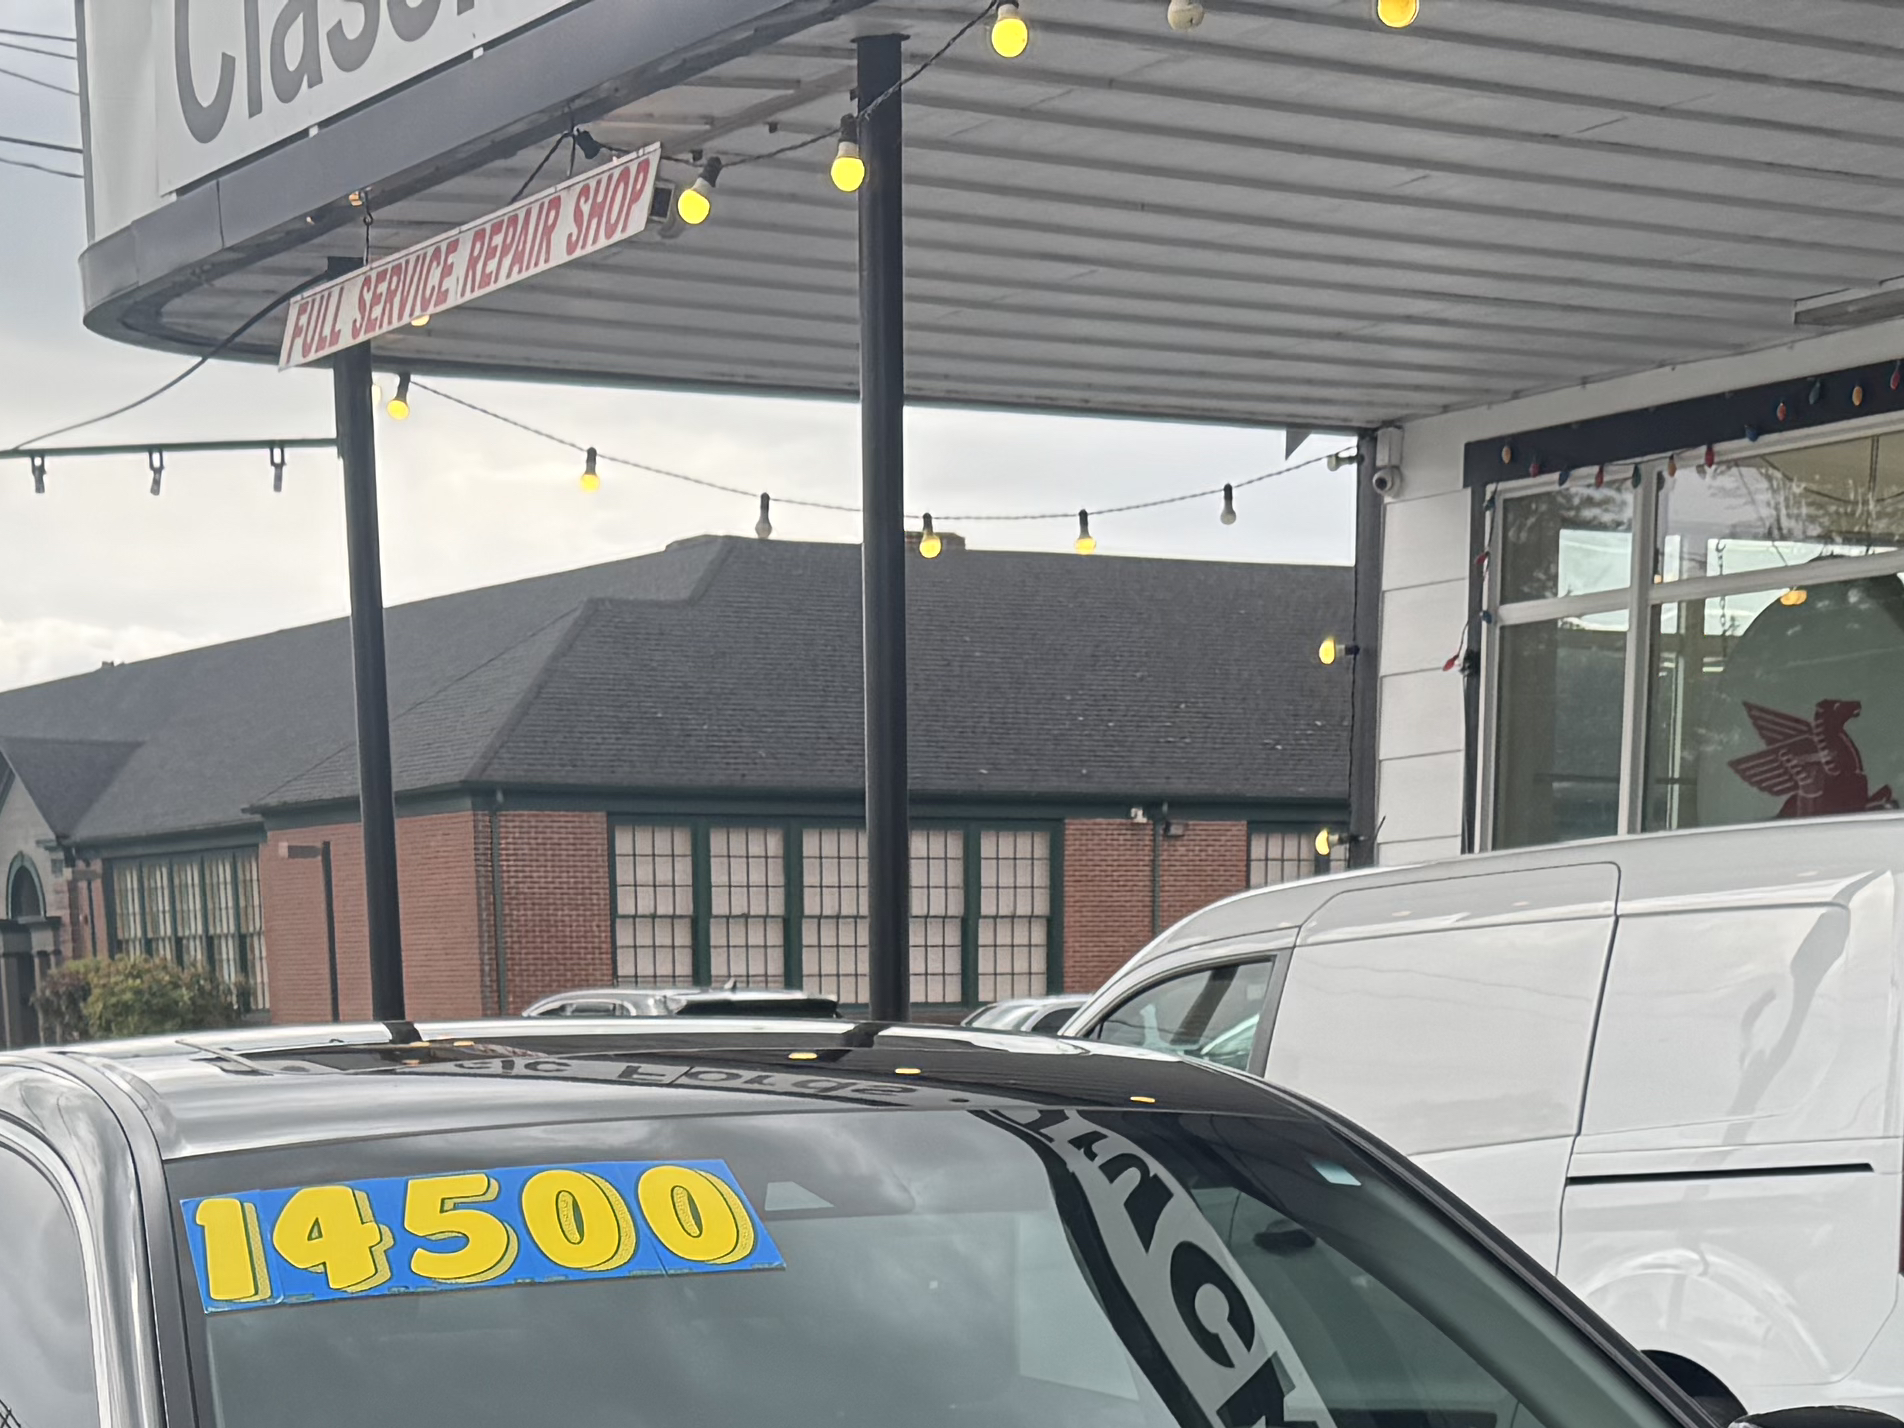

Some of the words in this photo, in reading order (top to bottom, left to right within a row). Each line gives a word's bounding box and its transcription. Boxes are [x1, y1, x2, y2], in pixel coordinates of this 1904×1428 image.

[286, 286, 345, 364] FULL
[351, 238, 459, 340] SERVICE
[460, 195, 562, 298] REPAIR
[566, 157, 651, 257] SHOP
[195, 1164, 755, 1304] 14500
